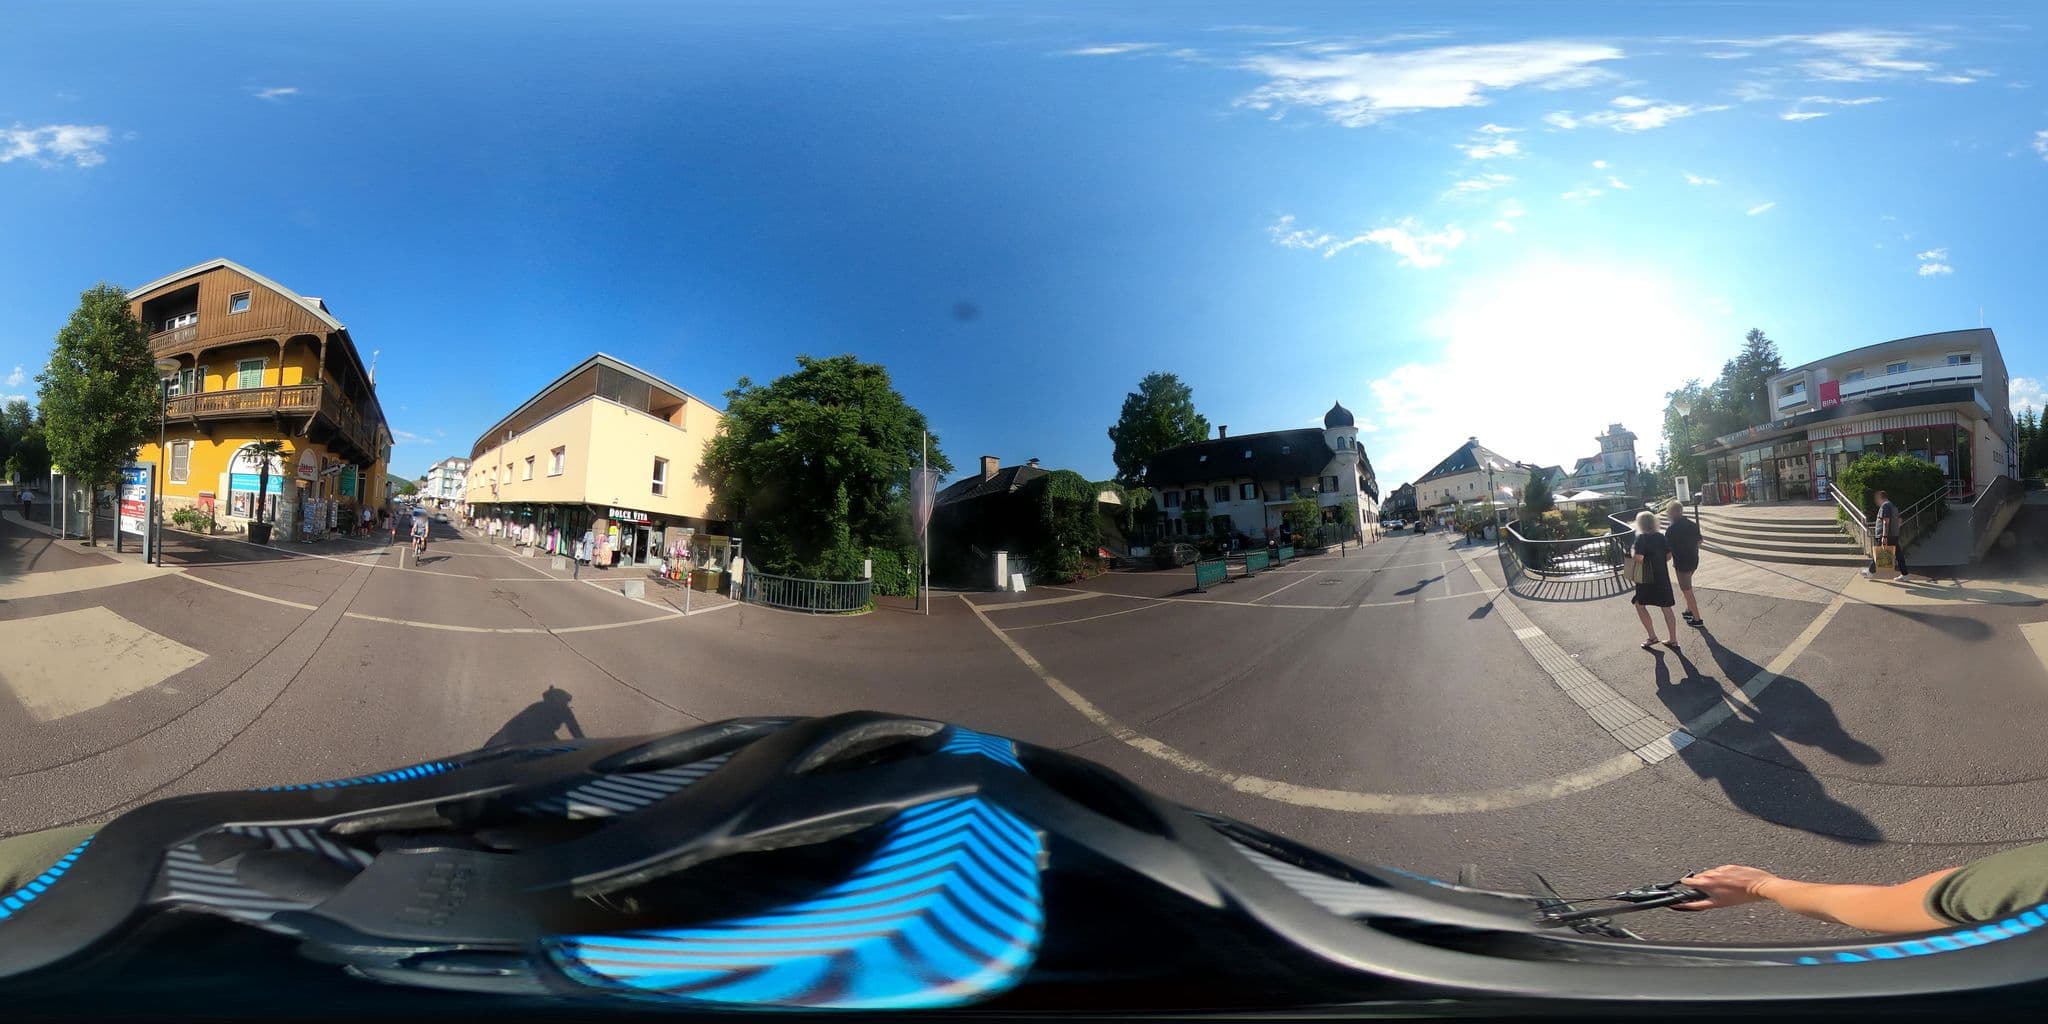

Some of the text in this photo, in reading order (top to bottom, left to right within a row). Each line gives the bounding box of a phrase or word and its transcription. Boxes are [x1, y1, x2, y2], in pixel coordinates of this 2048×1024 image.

[1822, 398, 1838, 408] BIPA
[140, 470, 147, 482] P
[139, 488, 146, 500] P
[609, 507, 648, 521] DOLCE VITA
